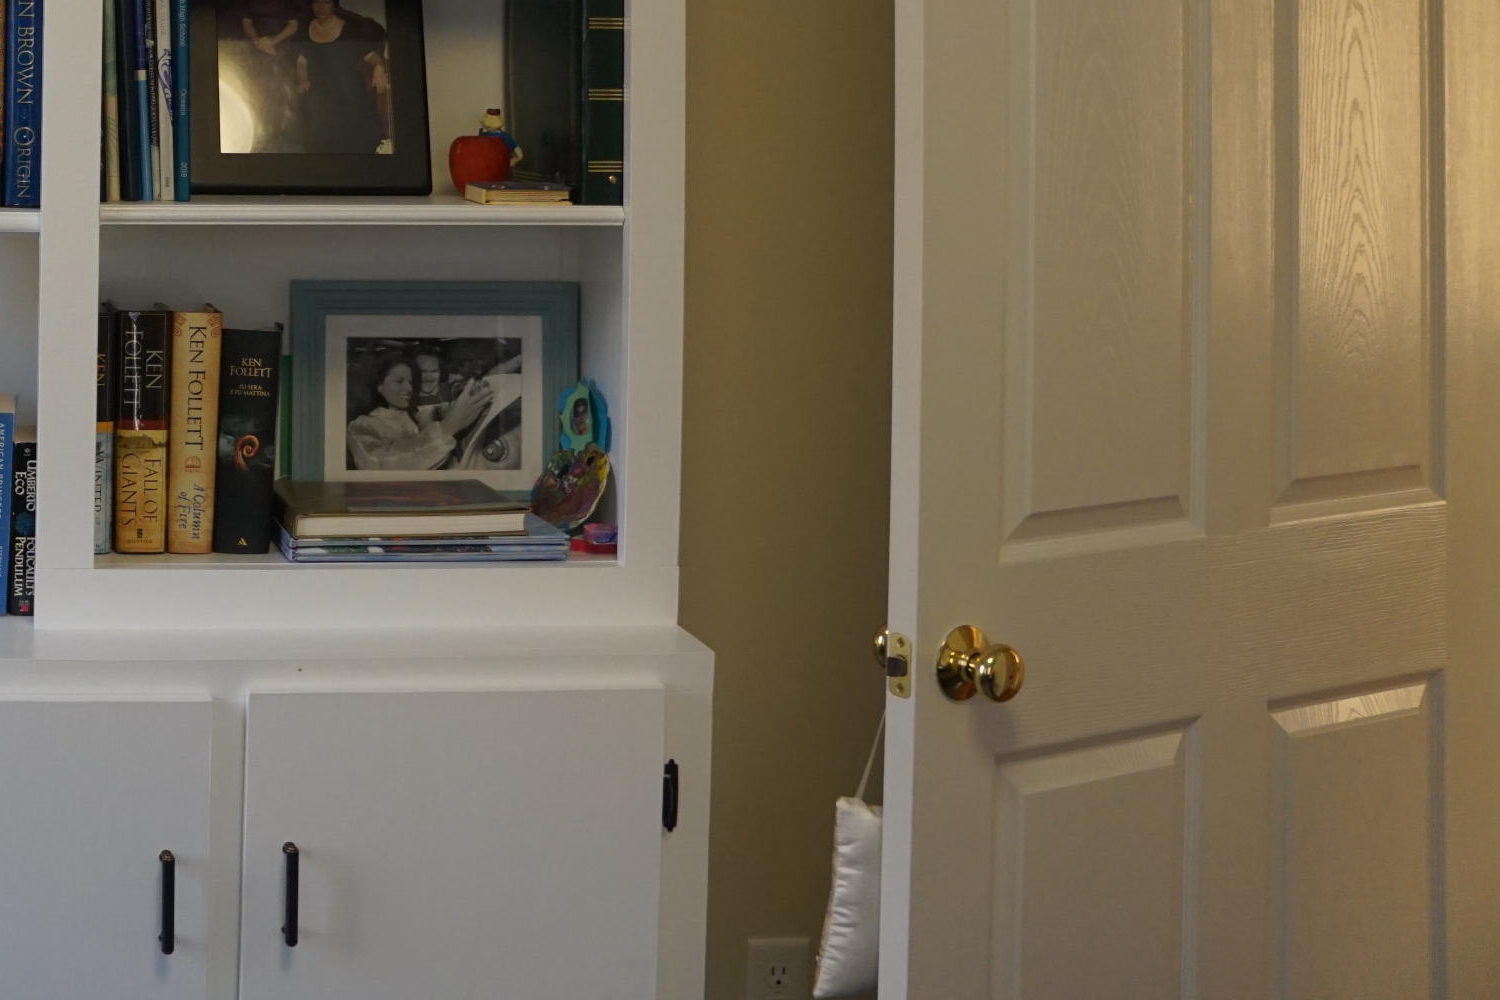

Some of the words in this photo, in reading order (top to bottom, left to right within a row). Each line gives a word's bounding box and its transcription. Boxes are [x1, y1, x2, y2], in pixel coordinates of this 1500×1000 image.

[16, 26, 34, 104] BROWN
[189, 326, 207, 364] KEN
[241, 359, 262, 367] KEN
[123, 330, 144, 406] FOLLETT
[144, 349, 163, 389] KEN
[228, 367, 273, 379] FOLLETT
[184, 370, 206, 451] FOLLETT
[14, 471, 26, 496] ECO
[120, 453, 138, 527] GIANTS
[143, 458, 162, 495] FALL
[142, 499, 159, 523] OF
[178, 491, 191, 501] of
[177, 504, 191, 529] Fire
[191, 494, 205, 540] Column
[13, 536, 26, 597] PENDULUM
